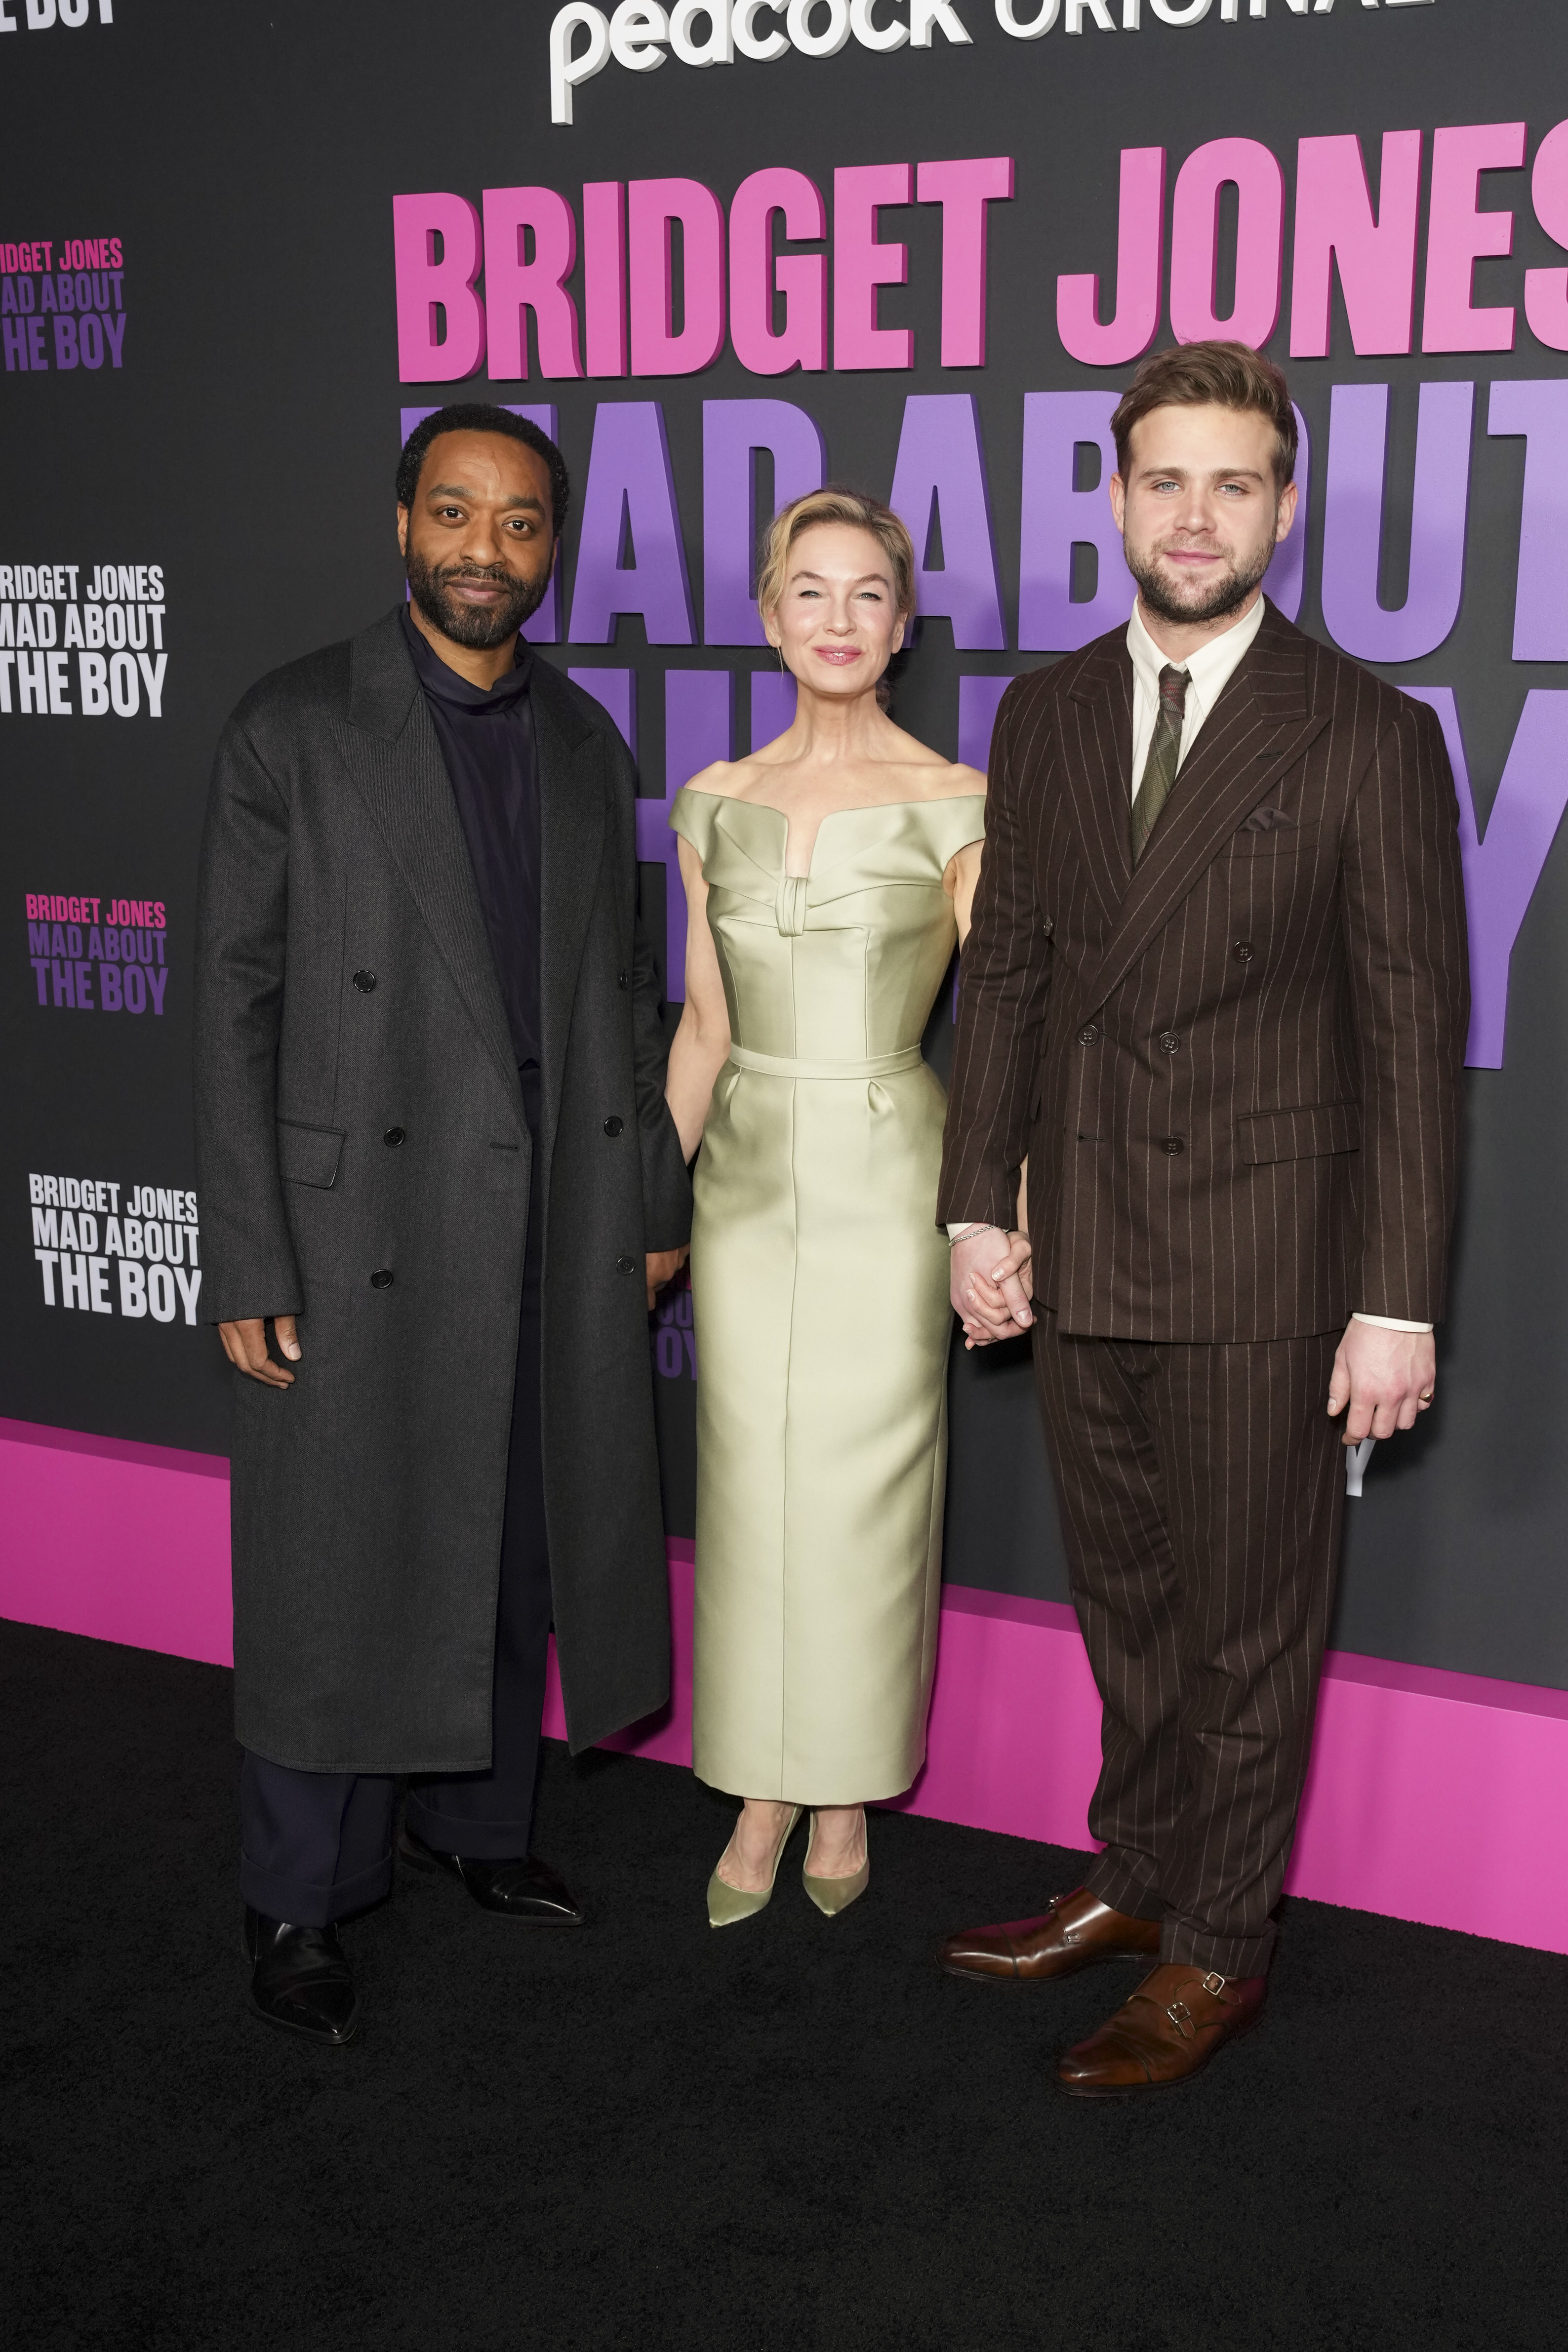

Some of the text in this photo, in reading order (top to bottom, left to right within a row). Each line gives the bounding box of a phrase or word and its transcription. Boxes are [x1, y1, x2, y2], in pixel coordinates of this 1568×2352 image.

[0, 238, 123, 273] IDGET JONES
[393, 158, 1015, 384] BRIDGET
[1, 271, 124, 315] AD ABOUT
[2, 313, 126, 371] HE BOY
[400, 380, 1568, 663] AD ABUT
[0, 565, 164, 601] RIDGET JONES
[64, 603, 165, 650] ABOUT
[79, 651, 168, 718] BOY
[26, 893, 166, 928] BRIDGET JONES
[28, 922, 167, 964] MAD ABOUT
[31, 957, 168, 1015] THE BOY
[29, 1173, 198, 1224] BRIDGET JONES
[32, 1206, 199, 1267] MAD ABOUT
[35, 1248, 202, 1326] THE BOY
